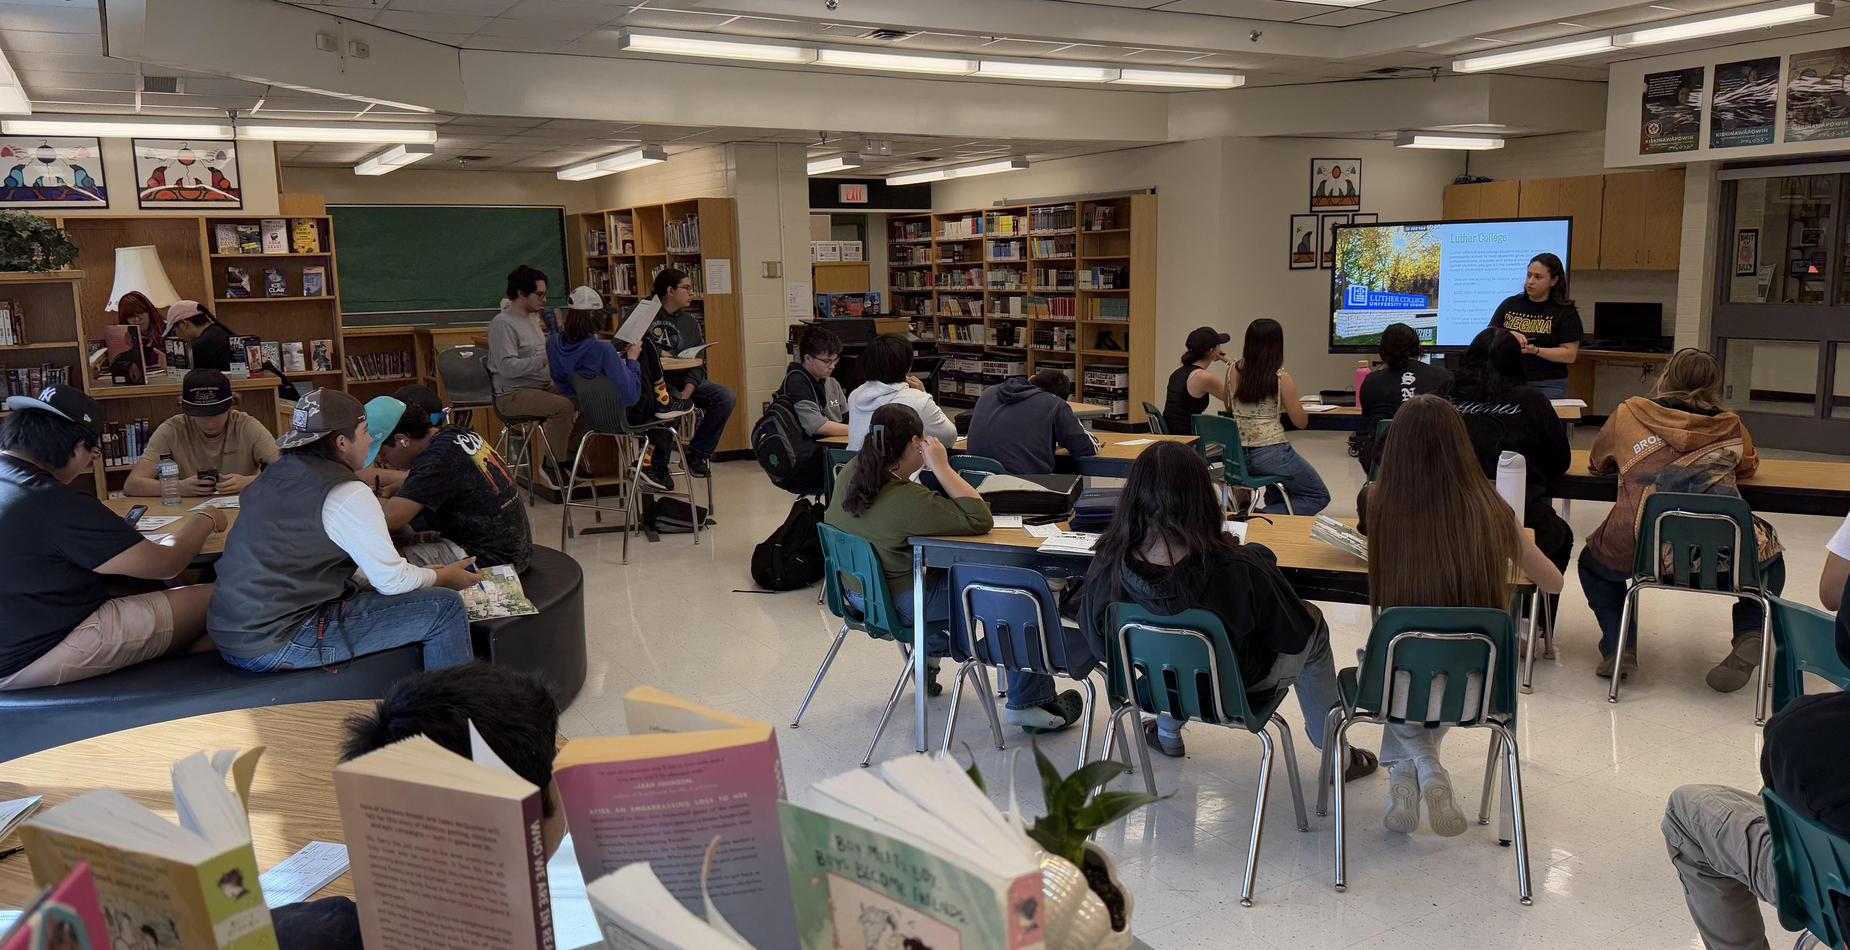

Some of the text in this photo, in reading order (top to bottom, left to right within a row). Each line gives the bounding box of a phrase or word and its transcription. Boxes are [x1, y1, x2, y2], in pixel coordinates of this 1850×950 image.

[846, 188, 862, 201] EXIT
[1450, 232, 1508, 244] Luther College
[1369, 294, 1425, 304] LUTHER COLLEGE
[1503, 313, 1552, 334] REGINA
[589, 807, 610, 816] AFTER
[615, 806, 627, 814] AN
[630, 801, 691, 813] EMBARRASSING
[694, 798, 714, 806] LOSS
[732, 791, 748, 800] HER
[530, 818, 543, 857] WHO
[534, 855, 546, 881] WE
[537, 881, 550, 909] ARE
[540, 909, 552, 928] IN
